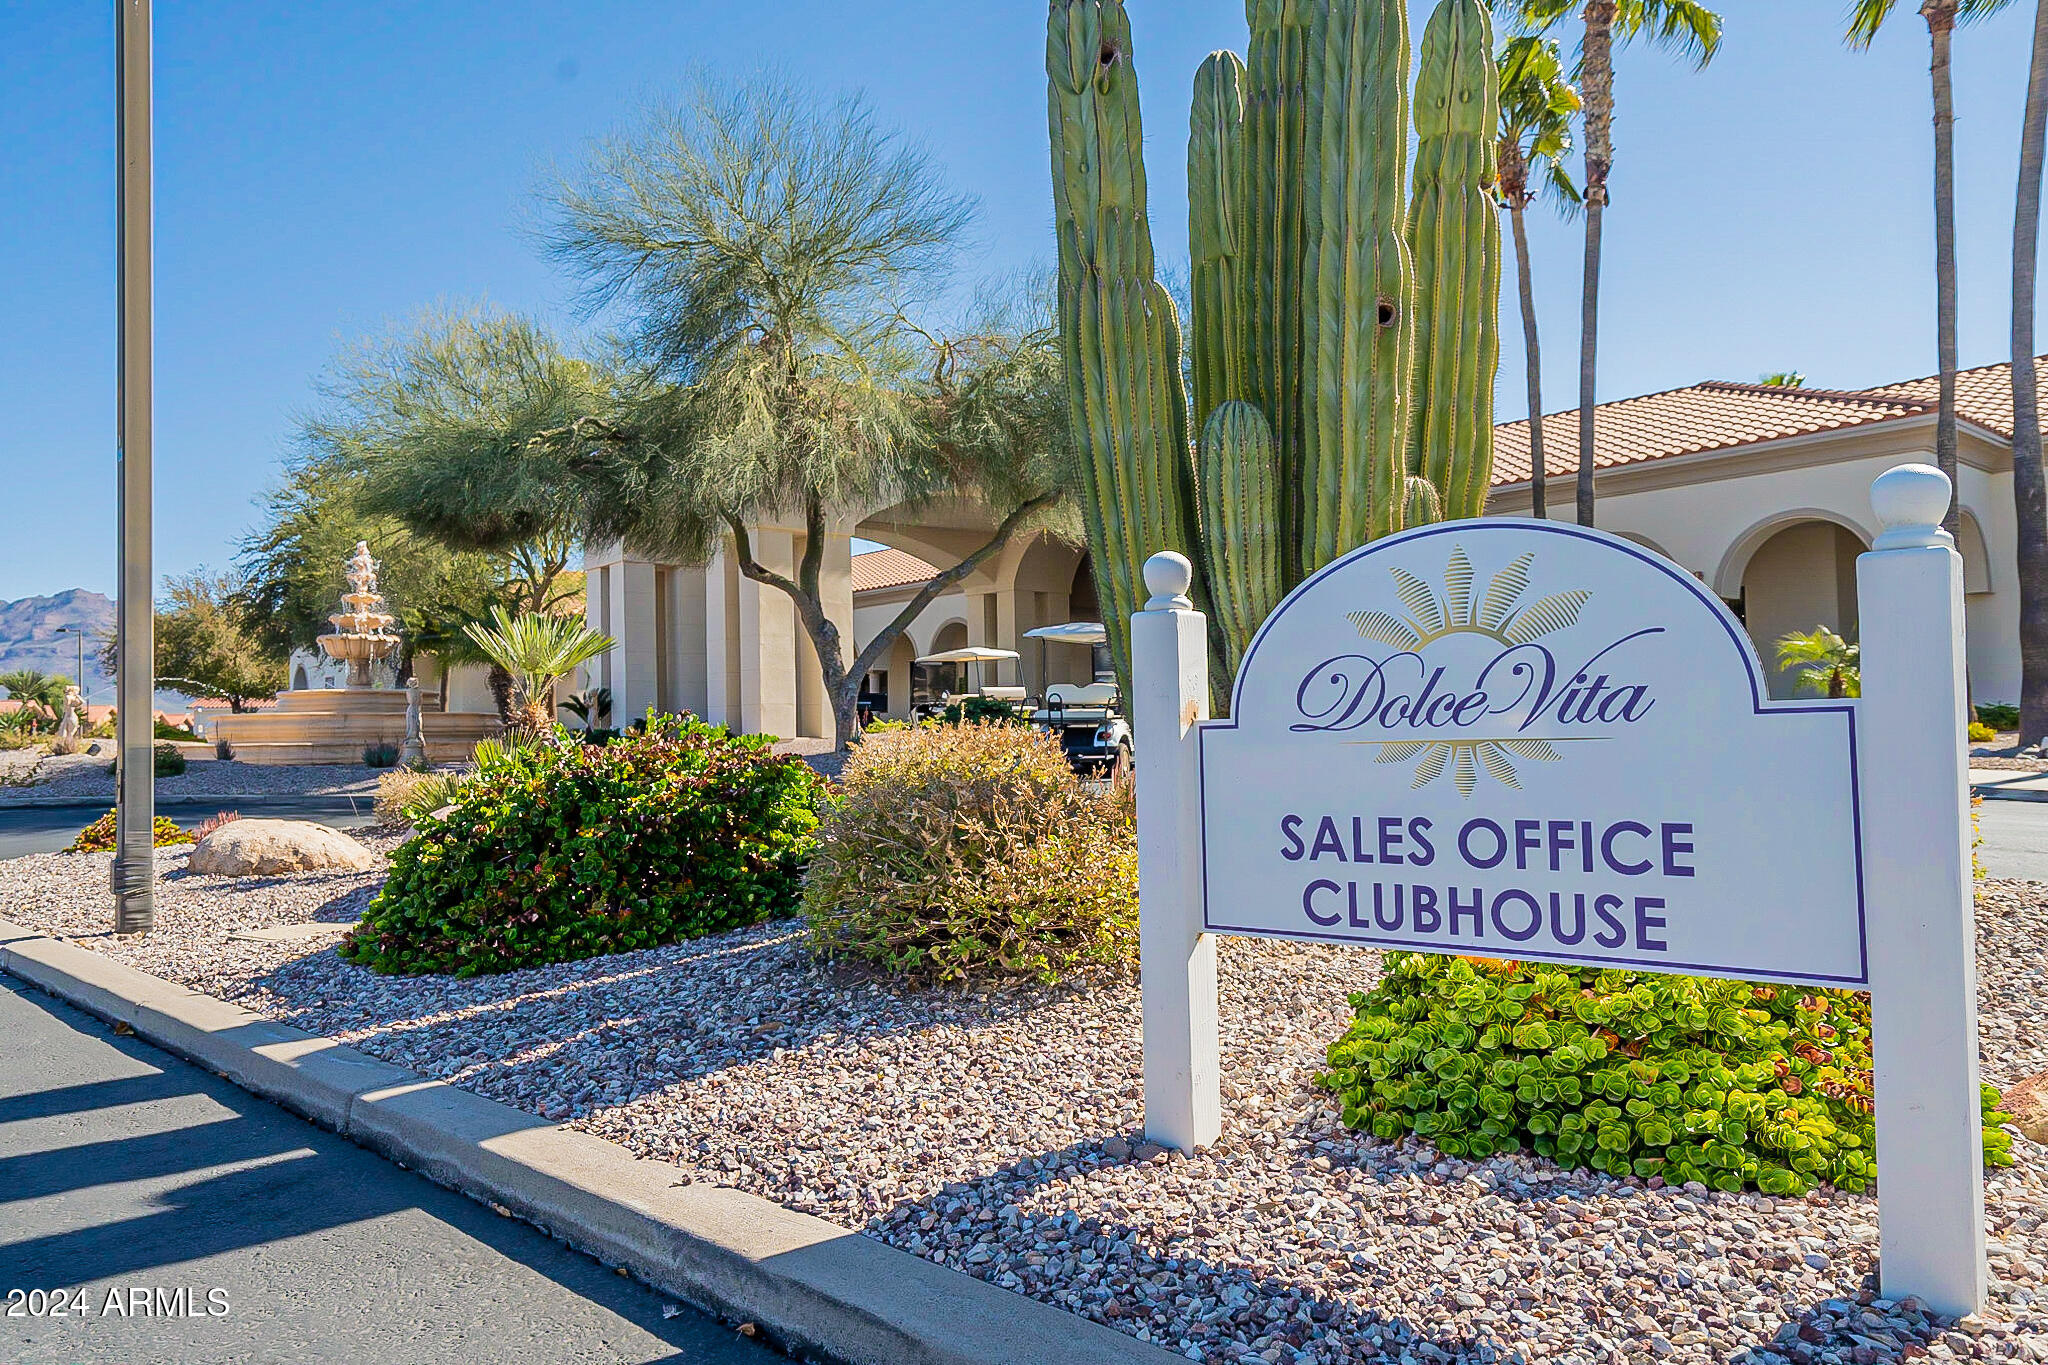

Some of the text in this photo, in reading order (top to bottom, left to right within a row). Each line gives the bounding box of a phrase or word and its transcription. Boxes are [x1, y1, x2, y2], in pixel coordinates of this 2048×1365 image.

[1289, 628, 1665, 733] Dolce Vita
[1280, 813, 1696, 878] SALES OFFICE
[1302, 878, 1668, 952] CLUBHOUSE
